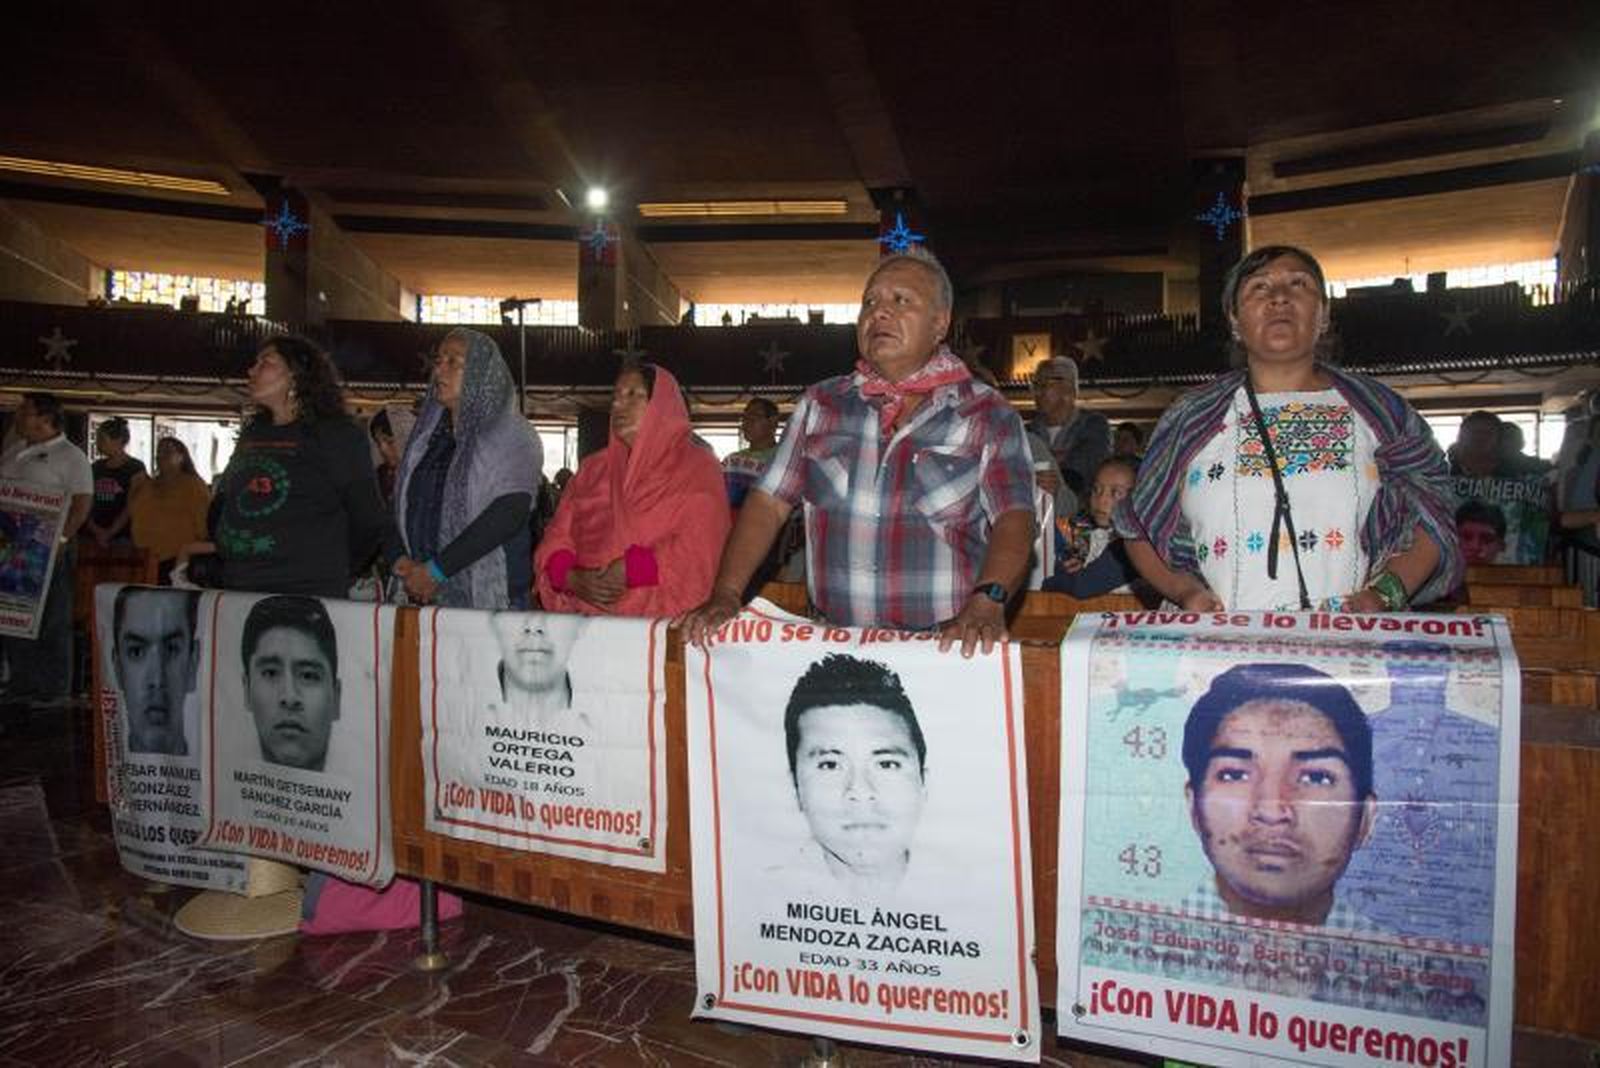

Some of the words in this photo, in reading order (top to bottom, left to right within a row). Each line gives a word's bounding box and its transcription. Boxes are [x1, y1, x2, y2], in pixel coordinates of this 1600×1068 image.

[782, 623, 814, 642] se
[1212, 613, 1250, 627] se
[1263, 612, 1296, 628] lo
[1309, 613, 1485, 636] llevaron!
[485, 725, 585, 747] MAURICIO
[1122, 725, 1167, 759] 43
[492, 742, 574, 762] ORTEGA
[488, 756, 576, 778] VALERIO
[484, 773, 518, 789] EDAD
[543, 782, 586, 797] AÑOS
[294, 800, 343, 819] GARCÍA
[443, 782, 475, 809] ¡Con
[479, 789, 517, 818] VIDA
[519, 796, 535, 822] lo
[540, 803, 642, 837] queremos!
[143, 826, 166, 843] LOS
[249, 825, 279, 850] VIDA
[281, 829, 294, 853] lo
[296, 839, 370, 873] queremos!
[1117, 843, 1162, 878] 43
[786, 903, 866, 926] MIGUEL
[871, 907, 948, 932] ÁNGEL
[760, 923, 860, 949] MENDOZA
[866, 934, 981, 959] ZACARIAS
[1151, 928, 1240, 958] Eduardo
[799, 951, 851, 968] EDAD
[856, 958, 879, 972] 33
[885, 959, 942, 977] AÑOS
[733, 962, 779, 994] ¡Con
[786, 968, 843, 1001] VIDA
[849, 974, 869, 1006] lo
[877, 982, 1009, 1020] queremos!
[1090, 980, 1153, 1019] ¡Con
[1165, 989, 1240, 1034] VIDA
[1249, 1002, 1279, 1040] lo
[1286, 1015, 1470, 1068] queremos!
